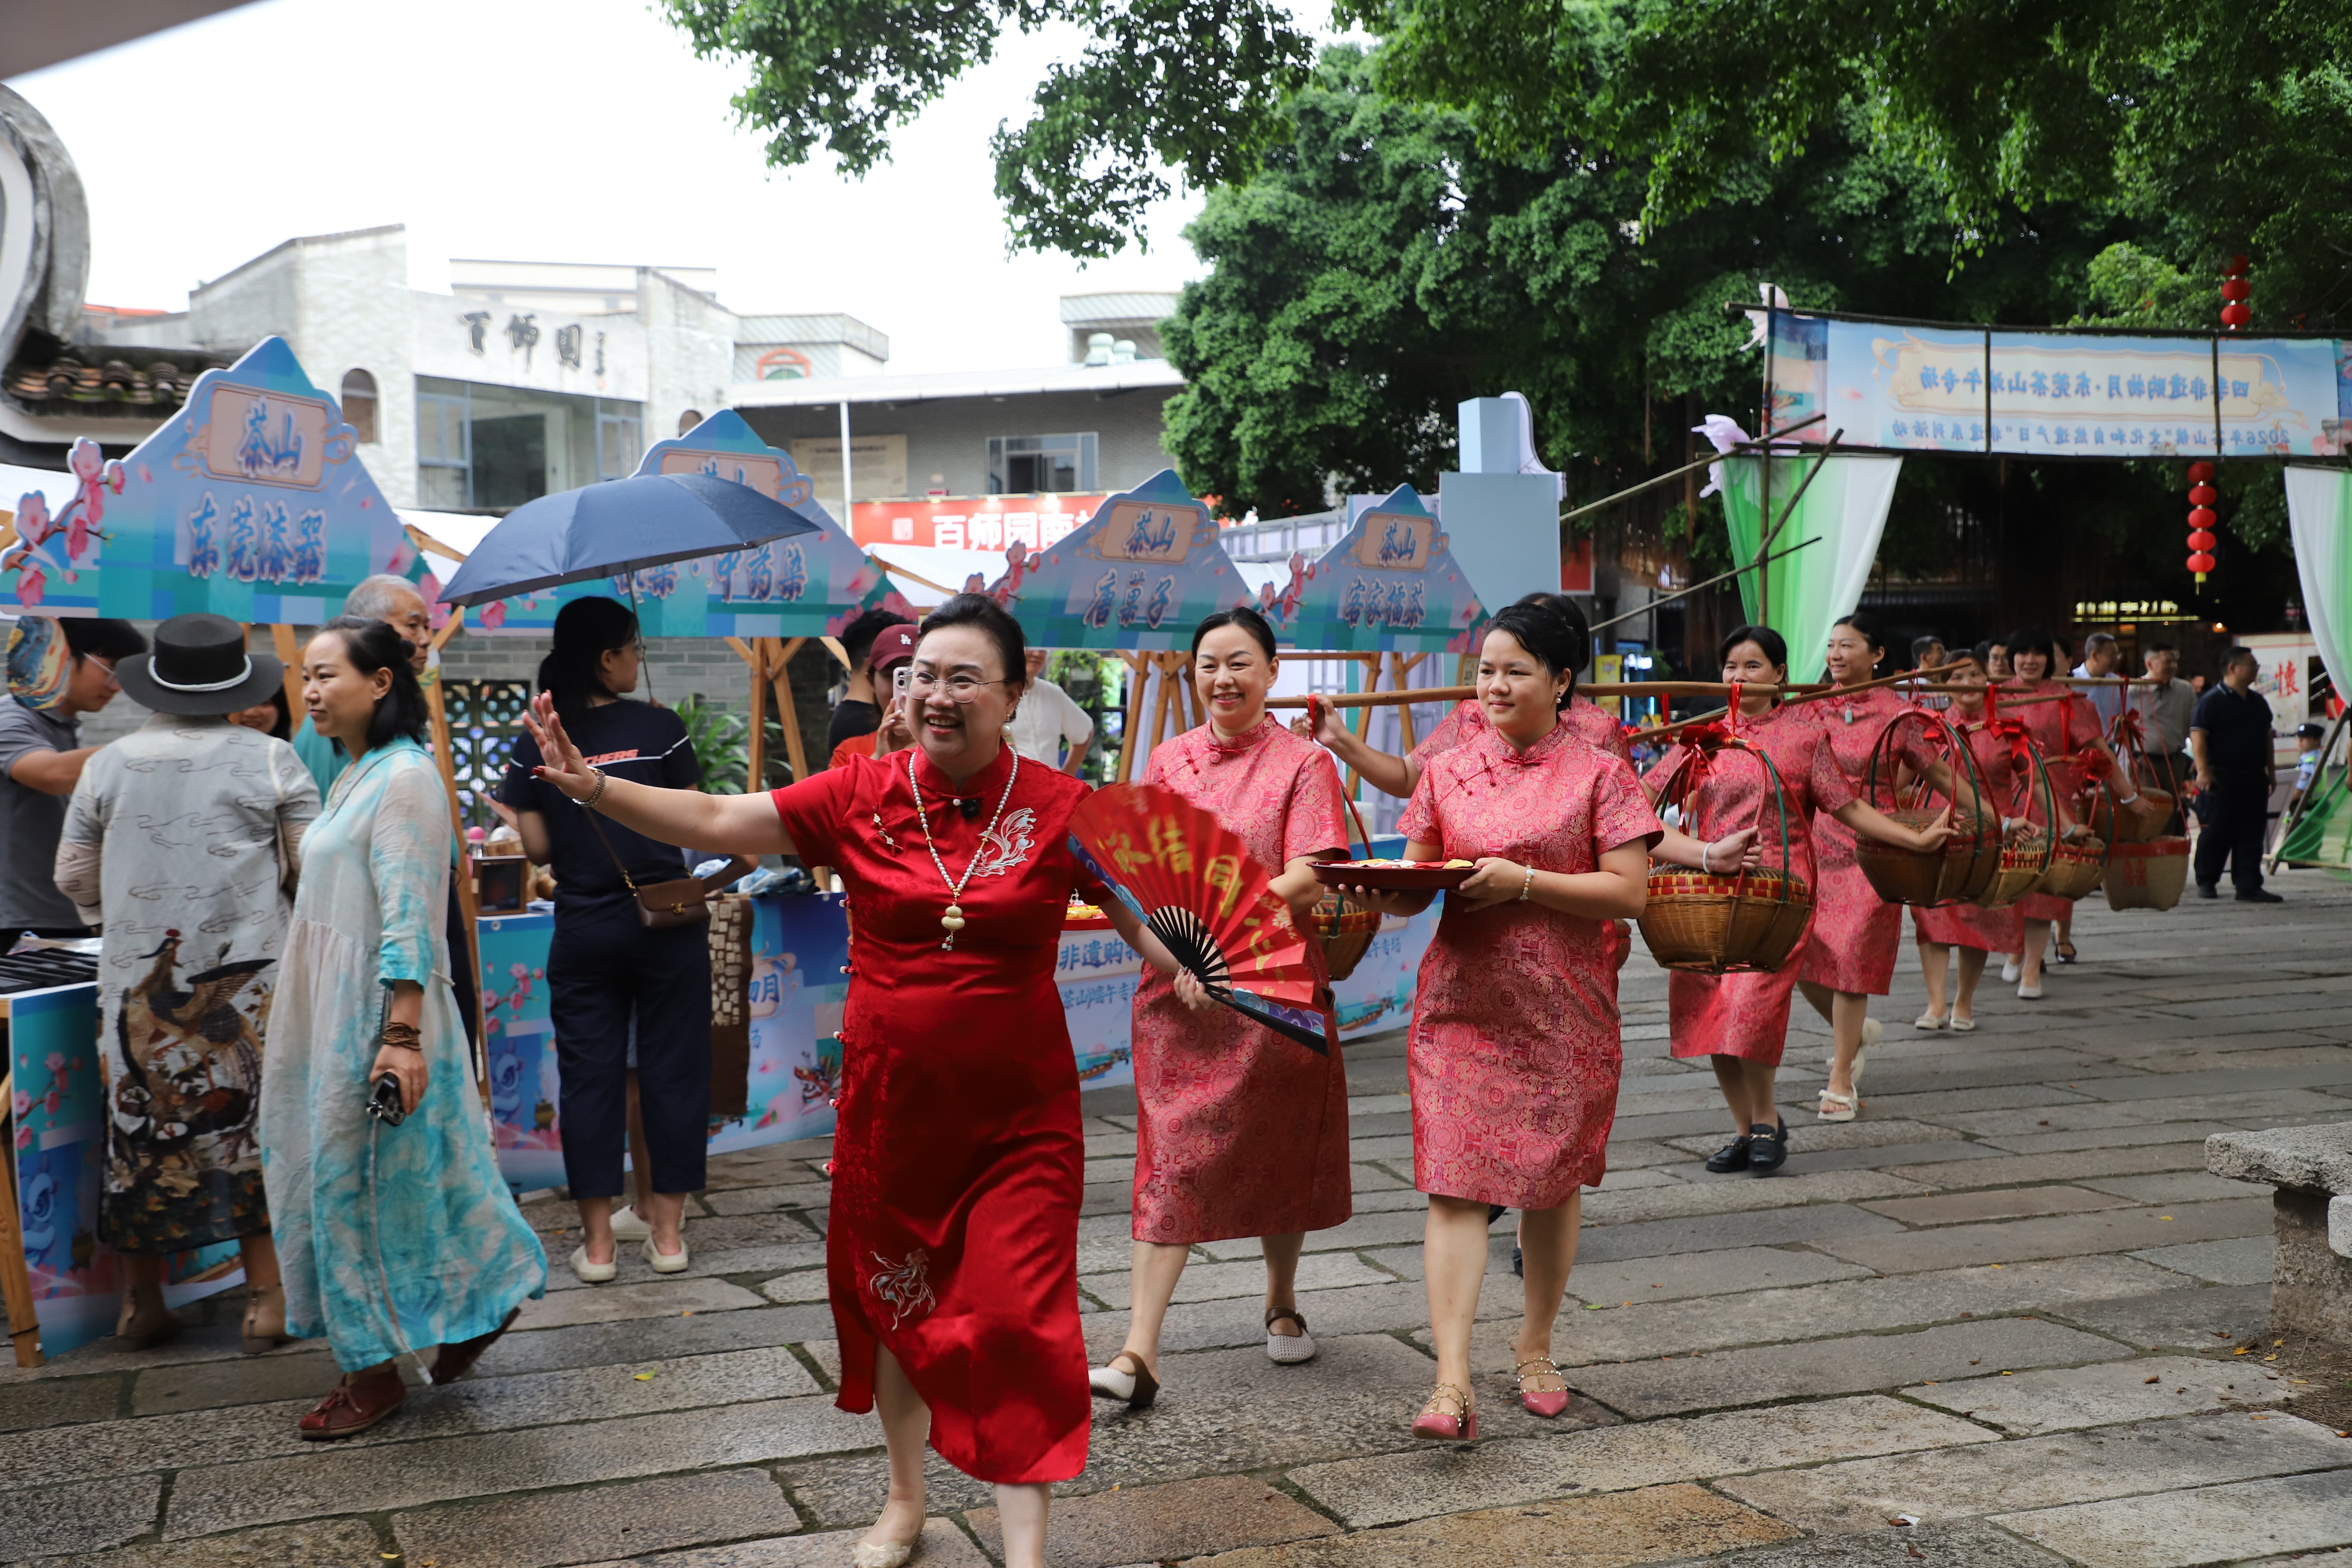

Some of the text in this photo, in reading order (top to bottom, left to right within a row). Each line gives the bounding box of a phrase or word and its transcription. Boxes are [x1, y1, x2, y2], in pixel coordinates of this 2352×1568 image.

[239, 400, 302, 470] 茶山
[1125, 510, 1176, 553] 茶山
[1378, 521, 1416, 562] 茶山
[1344, 577, 1425, 627] 客家擂茶
[900, 634, 911, 645] LA
